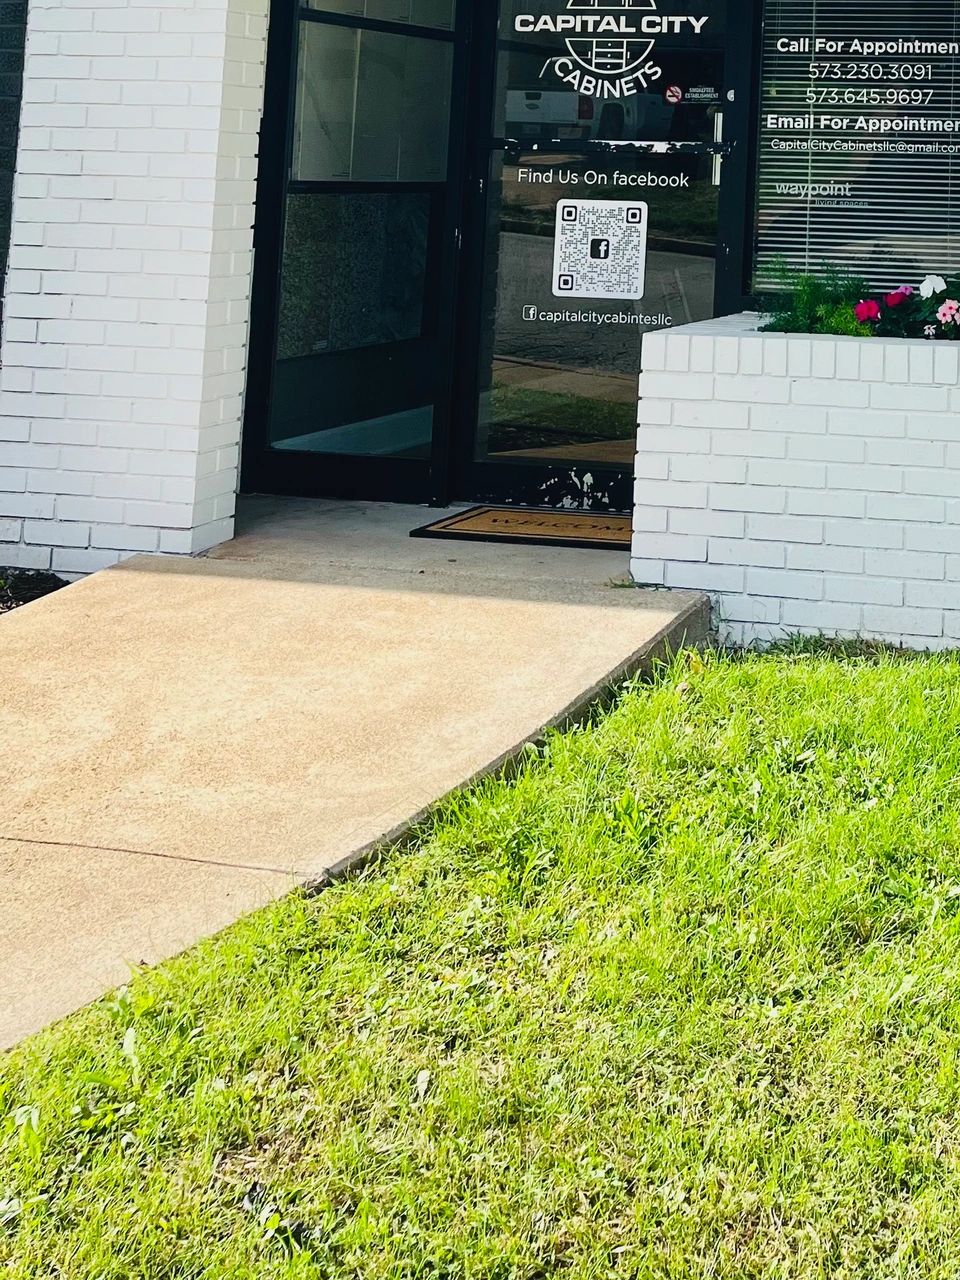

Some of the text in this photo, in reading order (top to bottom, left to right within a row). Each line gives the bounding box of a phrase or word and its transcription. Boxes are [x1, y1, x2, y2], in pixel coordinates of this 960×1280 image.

[514, 14, 709, 34] CAPITAL CITY
[776, 37, 809, 53] Call
[815, 38, 844, 53] For
[554, 58, 662, 99] CABINETS
[808, 63, 932, 80] 573.230.3091
[805, 88, 934, 105] 573.645.9697
[766, 115, 814, 129] Email
[820, 115, 850, 130] For
[517, 168, 690, 187] Find Us On facebook
[775, 180, 852, 199] waypoint
[538, 310, 673, 326] capitalcitycabintesllc
[491, 517, 633, 532] WELCOM
